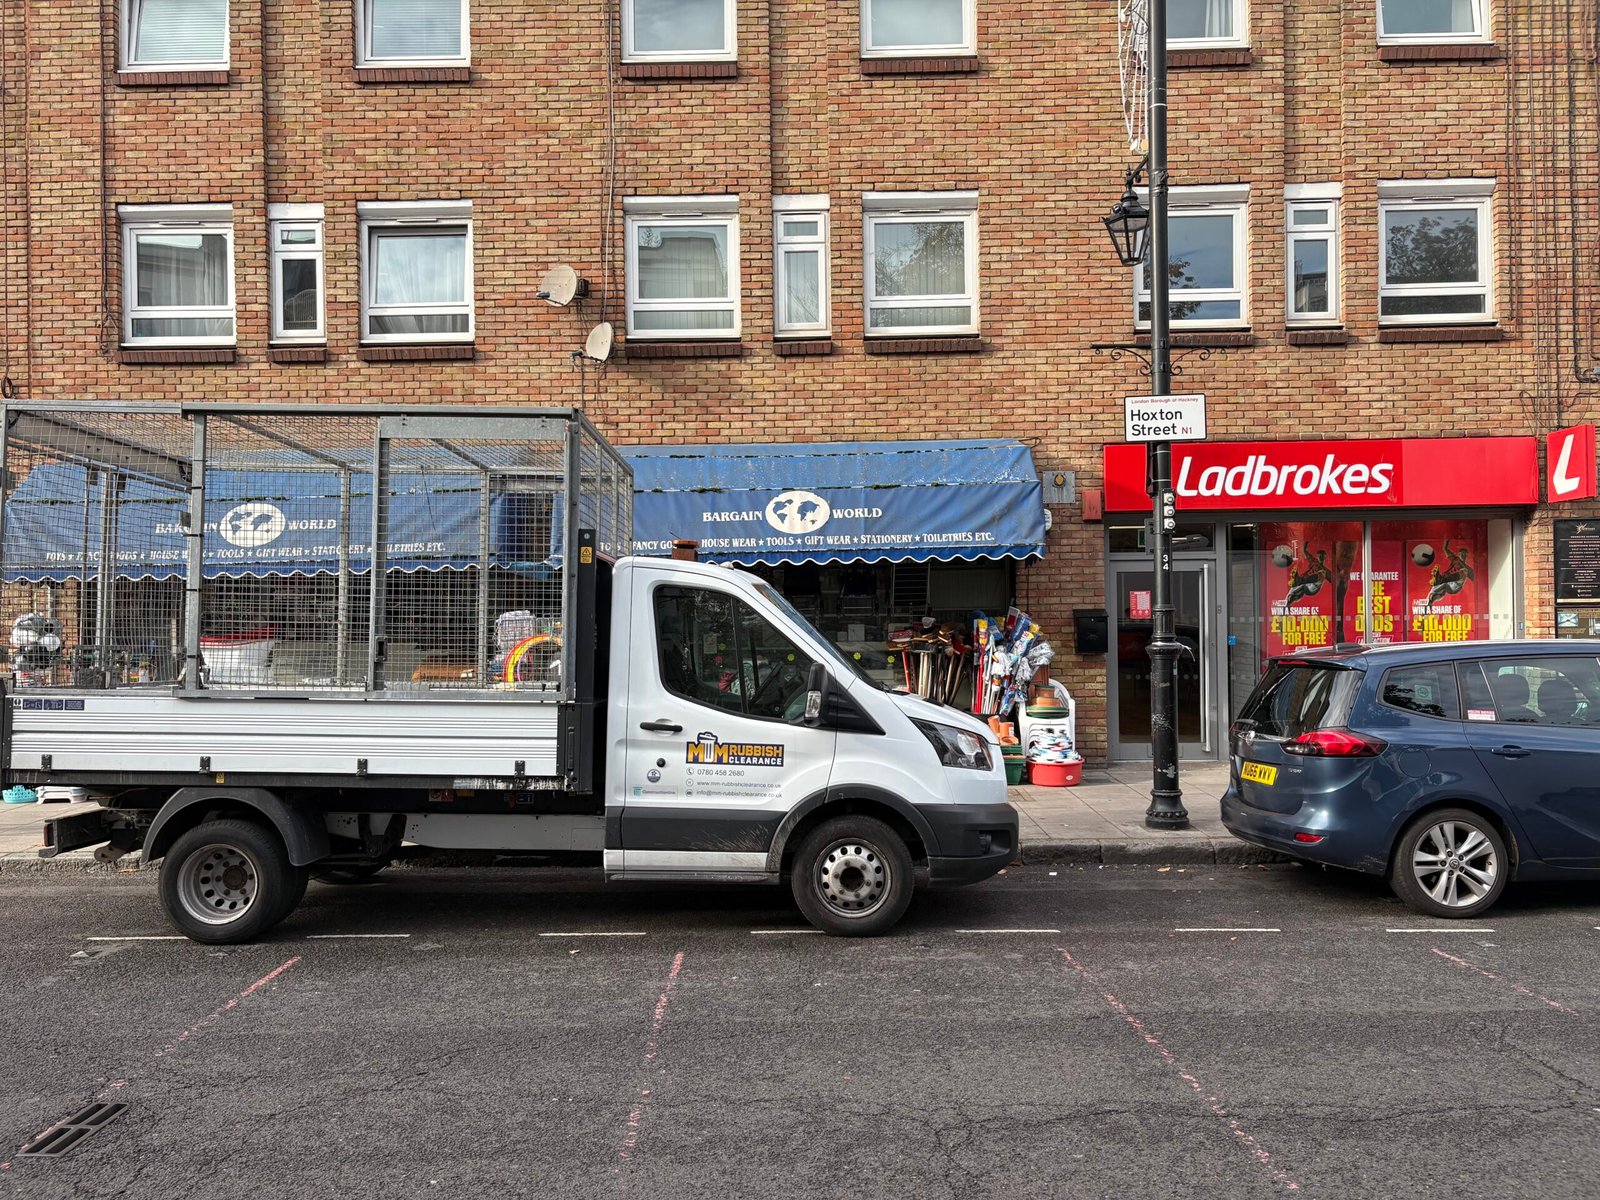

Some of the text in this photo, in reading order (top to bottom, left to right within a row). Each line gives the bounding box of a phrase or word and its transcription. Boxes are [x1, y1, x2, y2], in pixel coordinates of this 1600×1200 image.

[1130, 408, 1183, 421] Hoxton
[1131, 423, 1177, 436] Street
[1553, 434, 1580, 495] L
[1176, 454, 1394, 496] Ladbrokes
[702, 508, 882, 522] BARGAIN WORLD
[155, 519, 337, 534] BARIN WORLD
[599, 542, 622, 551] TOS
[633, 540, 659, 550] FANCY
[701, 538, 731, 548] HOUSE
[733, 538, 757, 547] WEAR
[766, 537, 794, 546] TOOLS
[804, 536, 824, 545] GIFT
[826, 535, 851, 545] WEAR
[860, 534, 912, 544] STATIONERY
[922, 532, 973, 542] TOILETRIES
[976, 532, 995, 541] ETC.
[46, 552, 66, 561] TOYS
[150, 550, 180, 560] HOUSE
[217, 548, 244, 558] TOOLS
[277, 546, 303, 557] WEAR
[1349, 571, 1360, 580] WE
[1371, 581, 1385, 596] HE
[1271, 606, 1284, 615] WIN
[1290, 606, 1310, 615] SHARE
[1357, 595, 1391, 614] BST
[1412, 606, 1425, 614] WIN
[1432, 605, 1453, 614] SHARE
[1453, 605, 1461, 613] OF
[1355, 614, 1394, 632] ODS
[1282, 631, 1327, 645] FOR FREE
[1423, 630, 1443, 642] FOR
[729, 744, 783, 757] RUBBISH
[728, 757, 782, 765] CLEARANCE
[728, 769, 745, 777] 2680
